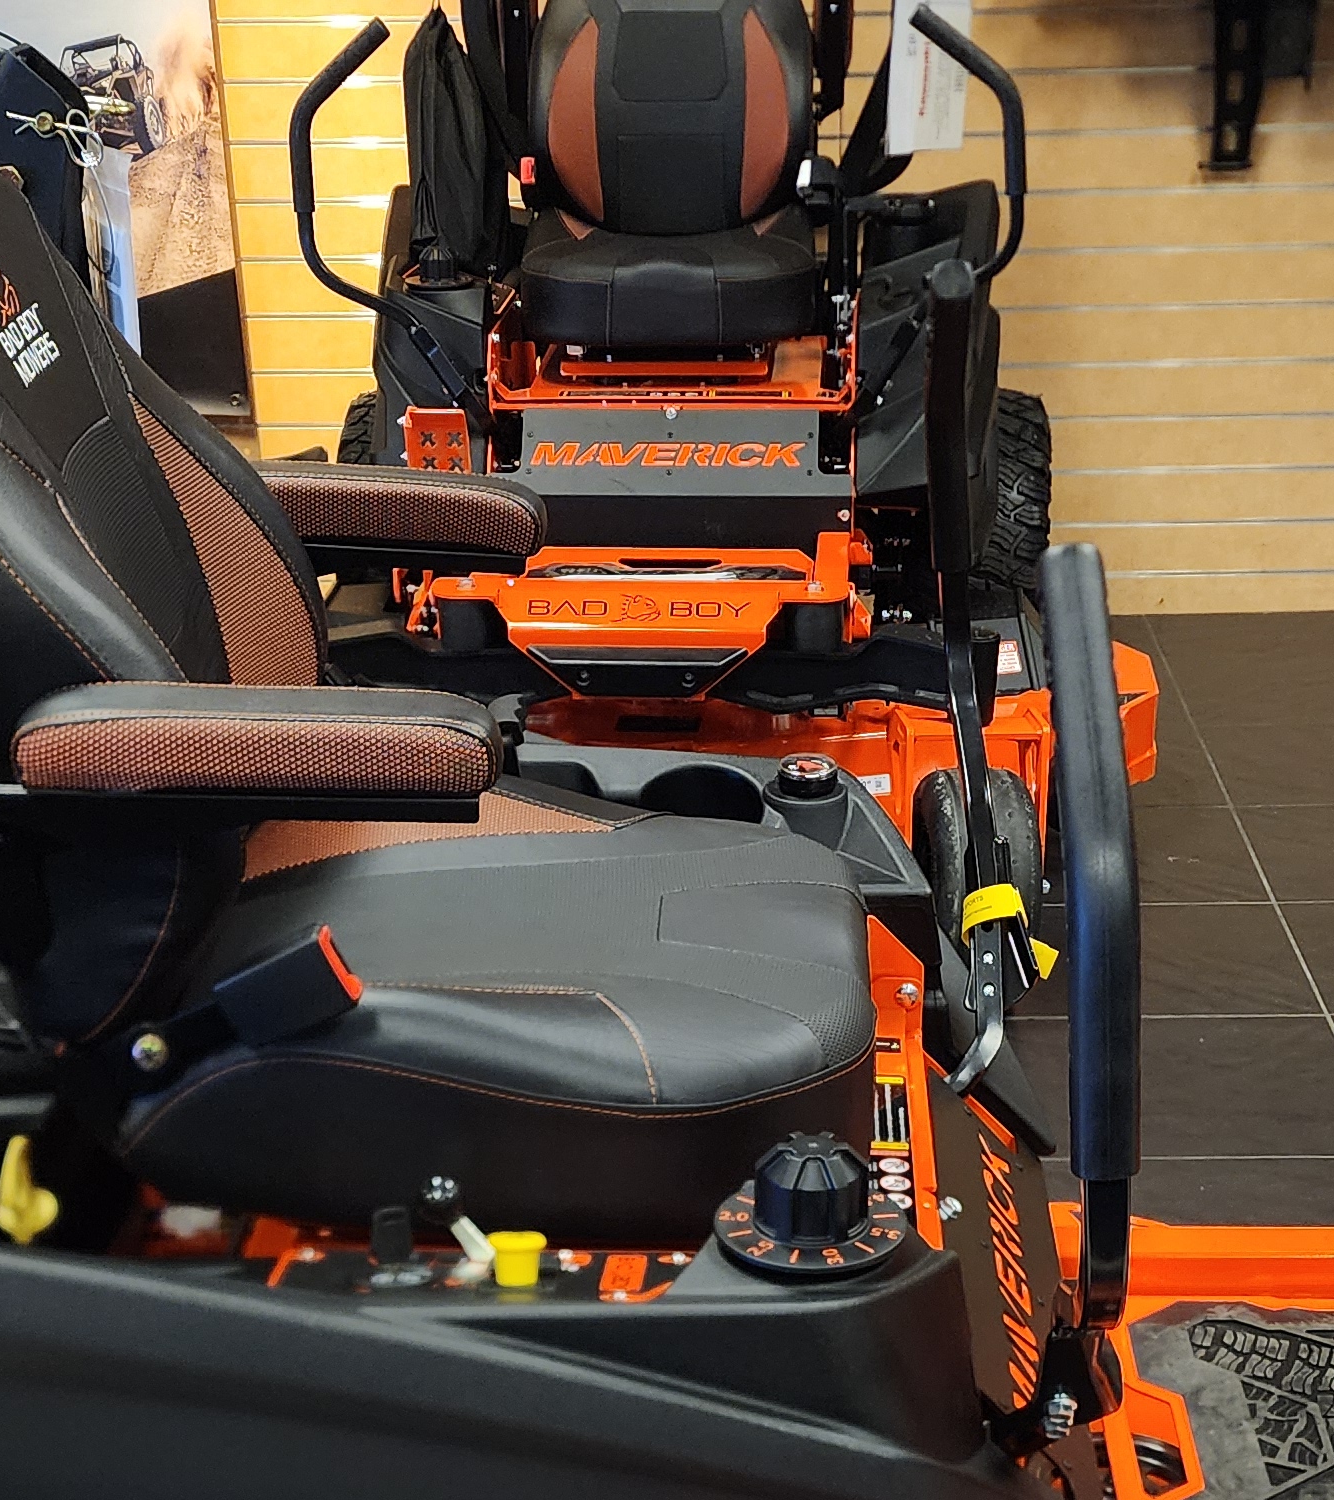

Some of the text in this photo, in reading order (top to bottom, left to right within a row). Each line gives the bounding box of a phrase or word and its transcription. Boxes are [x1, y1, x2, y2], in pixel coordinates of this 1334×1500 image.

[16, 303, 43, 341] BOY
[13, 332, 60, 388] MOWERS
[530, 441, 807, 467] MAVERICK
[527, 600, 751, 618] BAD BOY
[718, 1210, 750, 1222] 2.0
[977, 1130, 1042, 1411] MAVERICK
